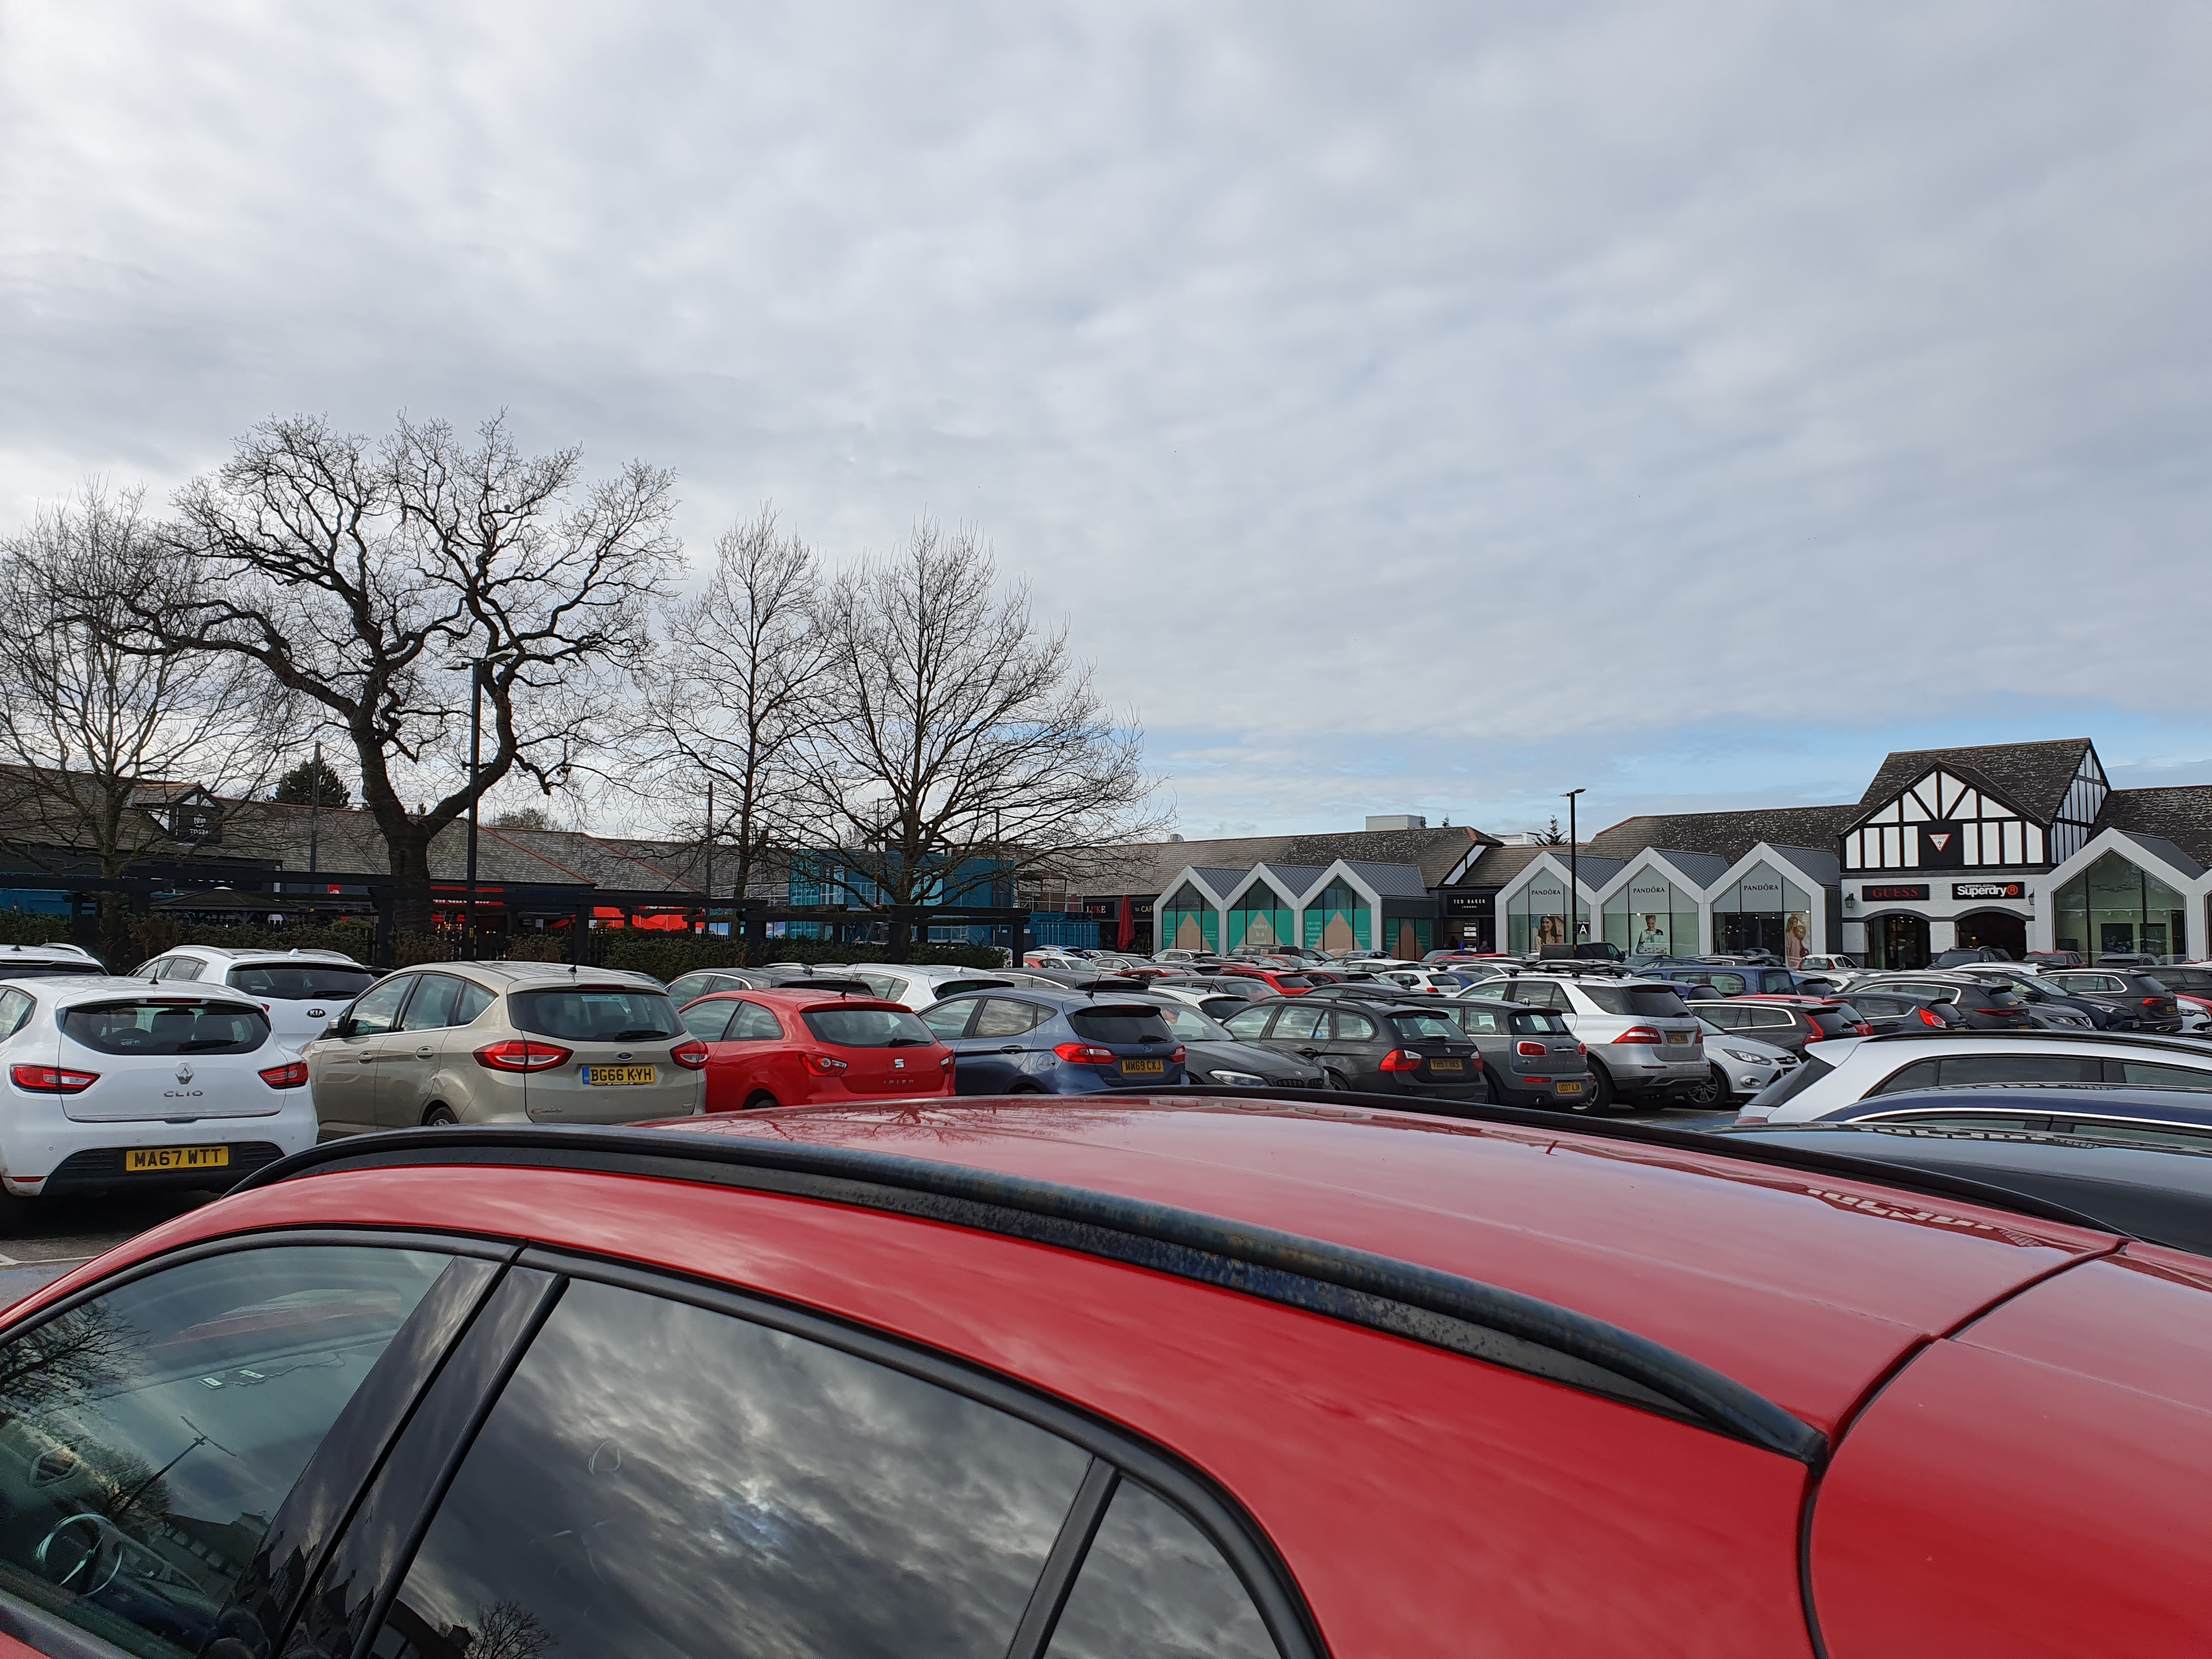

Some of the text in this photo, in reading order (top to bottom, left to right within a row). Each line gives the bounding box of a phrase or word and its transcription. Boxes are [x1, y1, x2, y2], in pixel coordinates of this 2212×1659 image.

[1872, 888, 1918, 898] GUESS
[1579, 924, 1587, 934] A
[1147, 1060, 1161, 1070] CXJ
[591, 1068, 651, 1081] BG66 KYH
[134, 1148, 222, 1167] MA67 WTT
